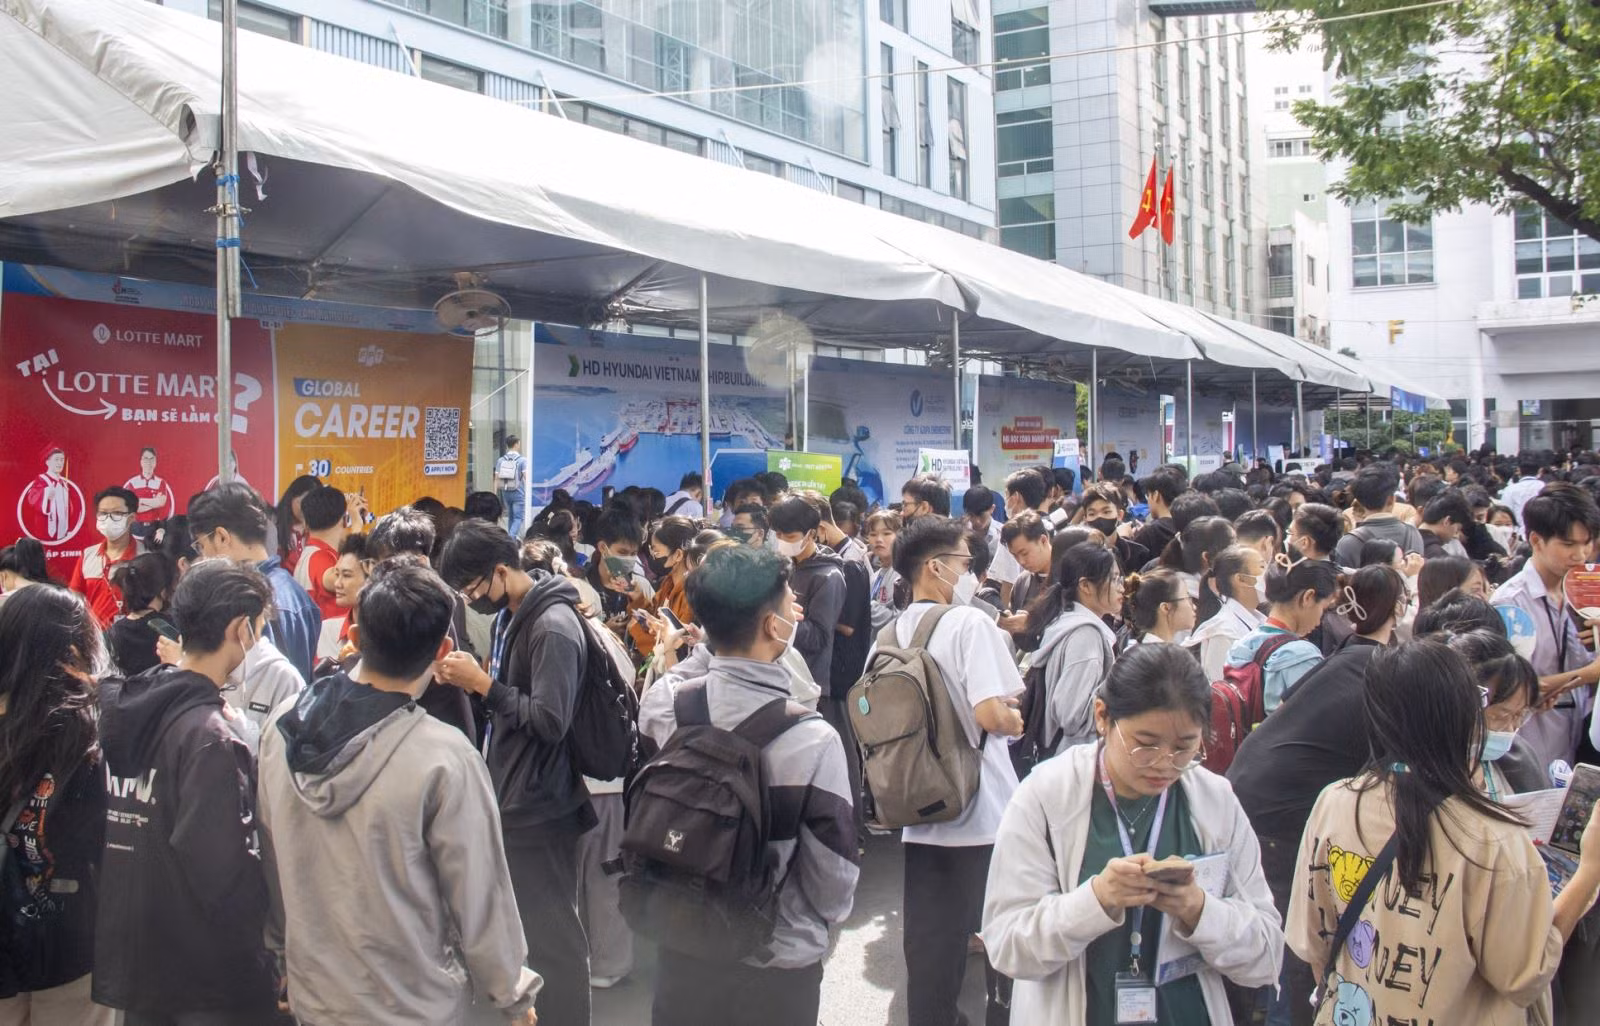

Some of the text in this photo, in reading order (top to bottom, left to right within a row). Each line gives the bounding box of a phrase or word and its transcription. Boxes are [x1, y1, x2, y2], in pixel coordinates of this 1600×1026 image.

[116, 330, 203, 348] LOTTE MART
[1388, 320, 1404, 344] F
[16, 349, 60, 377] TẠI
[583, 359, 600, 376] HD
[603, 361, 652, 380] HYUNDAI
[655, 366, 700, 383] VIETNAM
[57, 370, 149, 395] LOTTE
[302, 379, 361, 397] GLOBAL
[121, 407, 158, 426] BẠN
[161, 407, 178, 422] SẼ
[181, 404, 210, 423] LÀM
[294, 402, 420, 439] CAREER
[308, 459, 375, 477] 30 COUNTRIES
[931, 458, 943, 471] HD
[45, 549, 82, 561] ẬP SINH
